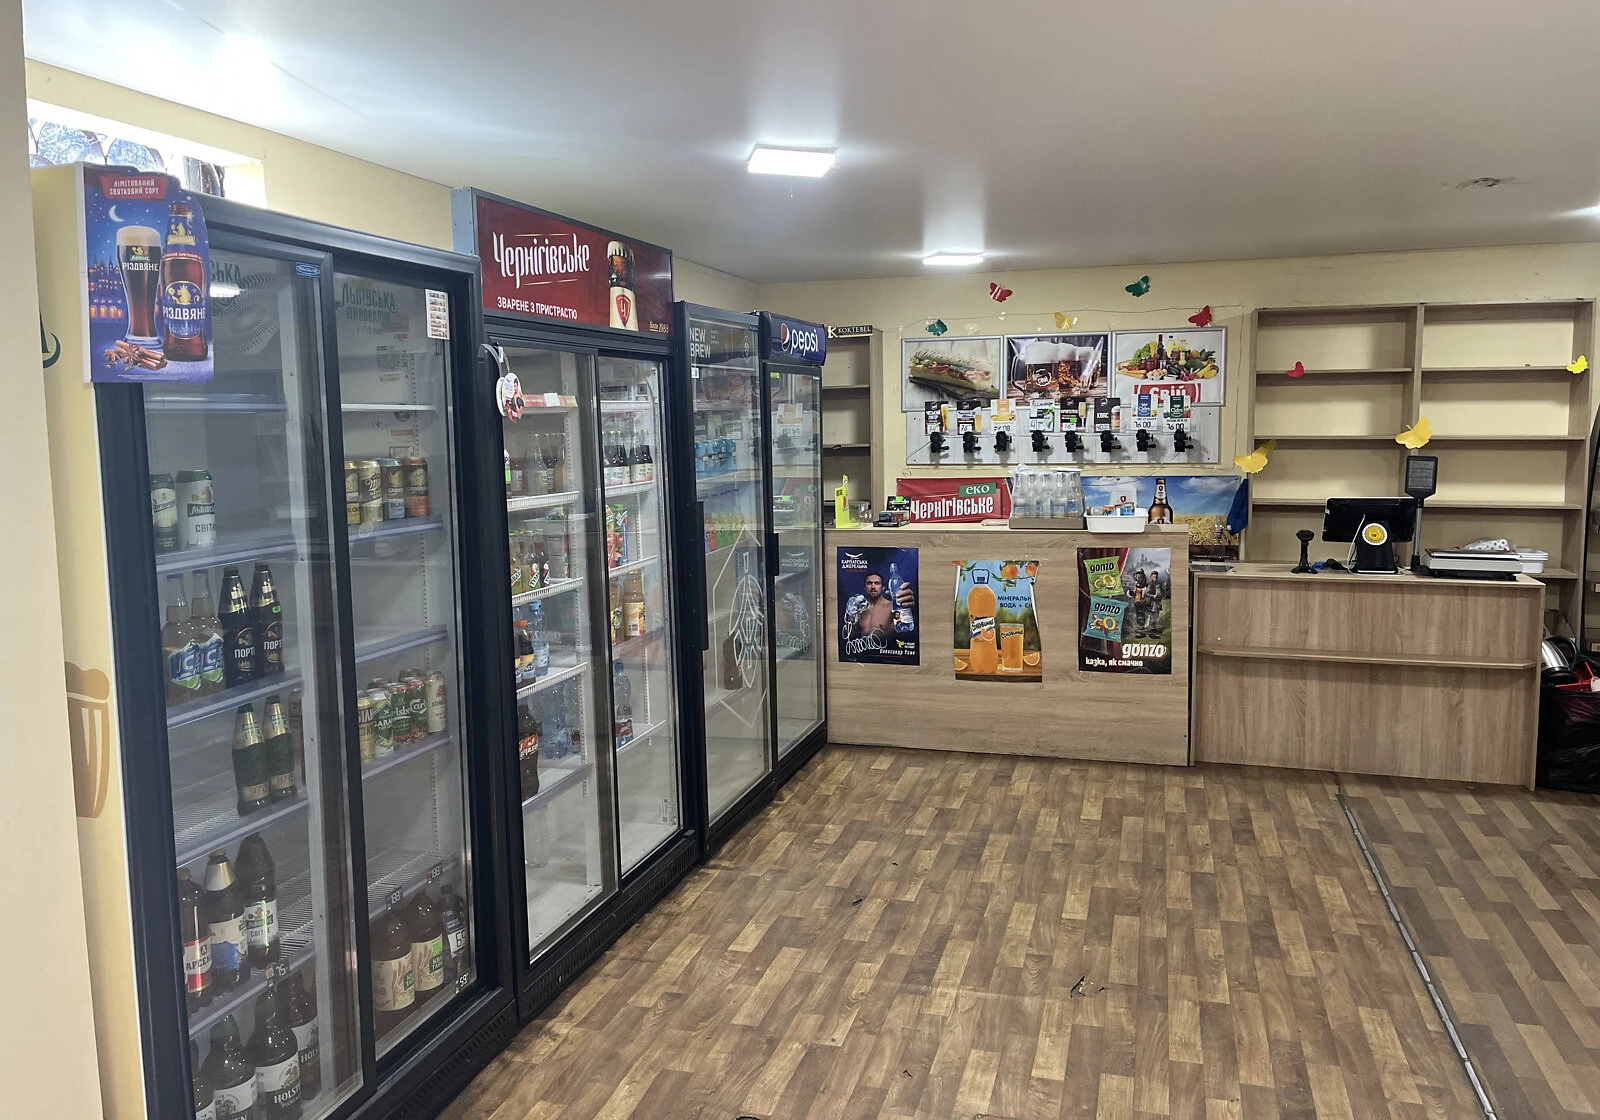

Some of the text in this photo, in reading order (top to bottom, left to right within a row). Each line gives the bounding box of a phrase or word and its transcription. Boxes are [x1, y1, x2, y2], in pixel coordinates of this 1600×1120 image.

[144, 187, 159, 195] СОРТ
[122, 262, 159, 272] РІЗДВЯНЕ
[492, 231, 590, 289] Чернігівське
[162, 305, 206, 320] РІЗДВЯНЕ
[497, 296, 530, 312] ЗВАРЕНЕ
[535, 303, 578, 320] ПРИСТРАСТЮ
[689, 326, 706, 343] NEW
[838, 326, 872, 335] KOKTEBEL
[689, 342, 712, 358] BREW
[790, 328, 819, 357] pepsi
[1090, 562, 1115, 574] gonzo
[1094, 602, 1121, 615] gonzo
[1122, 642, 1168, 659] gonzo
[1085, 657, 1144, 667] казка, як смачно
